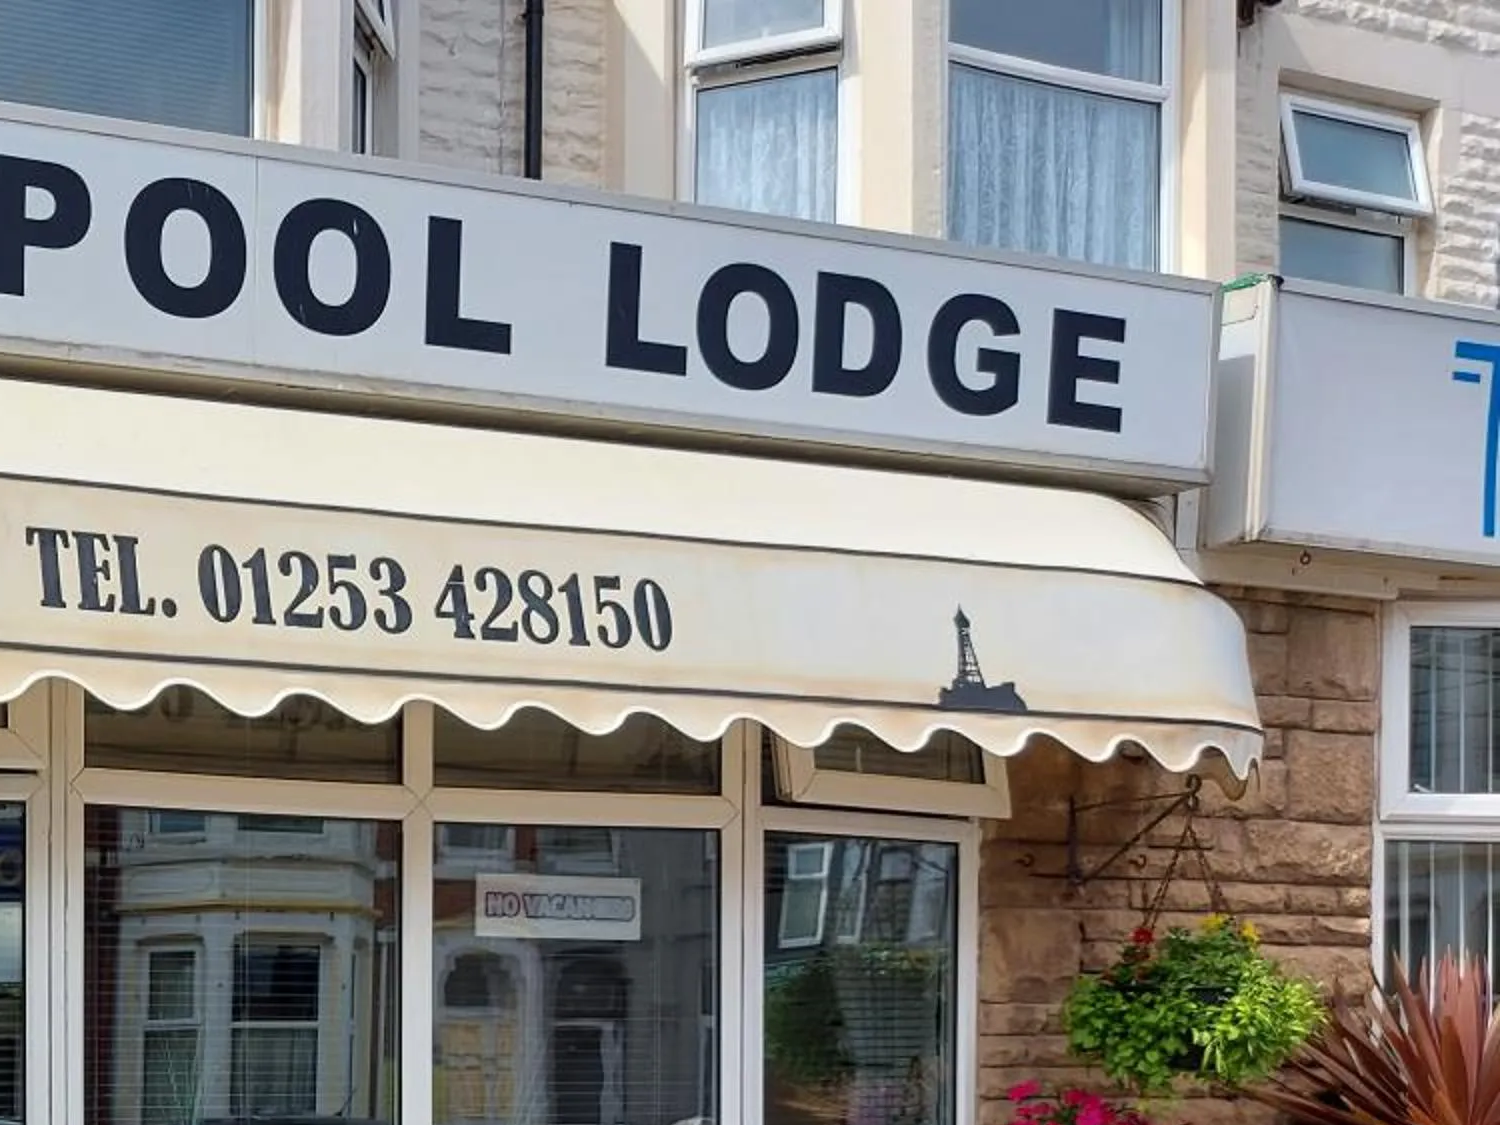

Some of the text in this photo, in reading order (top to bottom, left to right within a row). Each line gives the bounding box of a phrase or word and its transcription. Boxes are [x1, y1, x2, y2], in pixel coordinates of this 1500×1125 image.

[606, 242, 1127, 433] LODGE
[25, 526, 673, 652] TEL. 01253 428150
[485, 891, 521, 917] NO
